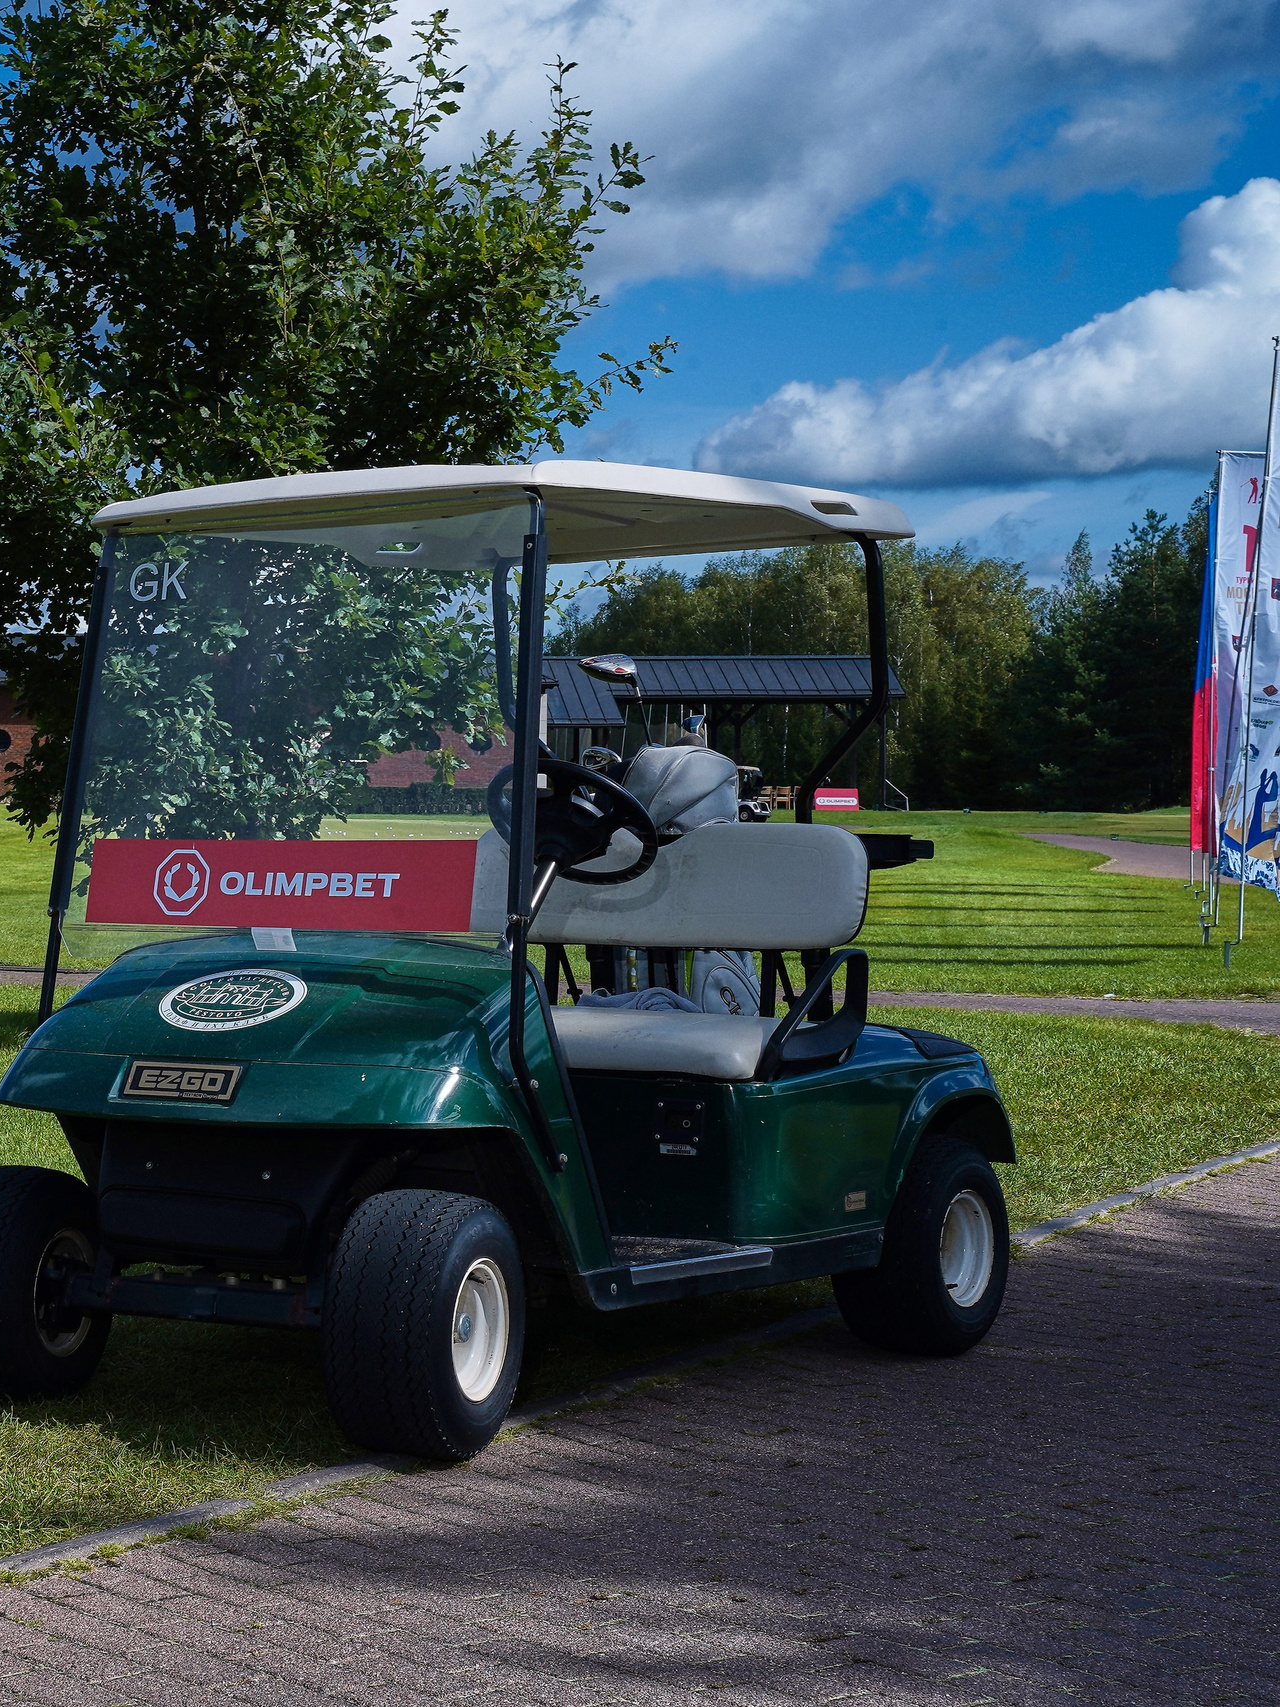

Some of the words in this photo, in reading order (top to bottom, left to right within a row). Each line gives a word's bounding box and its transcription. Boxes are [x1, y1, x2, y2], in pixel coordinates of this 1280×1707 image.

[130, 561, 189, 601] GK
[220, 871, 400, 897] OLIMPBET
[163, 1009, 189, 1025] ГОЛЬФ
[233, 1014, 269, 1027] КЛУБ
[189, 1009, 242, 1017] PESTOVO
